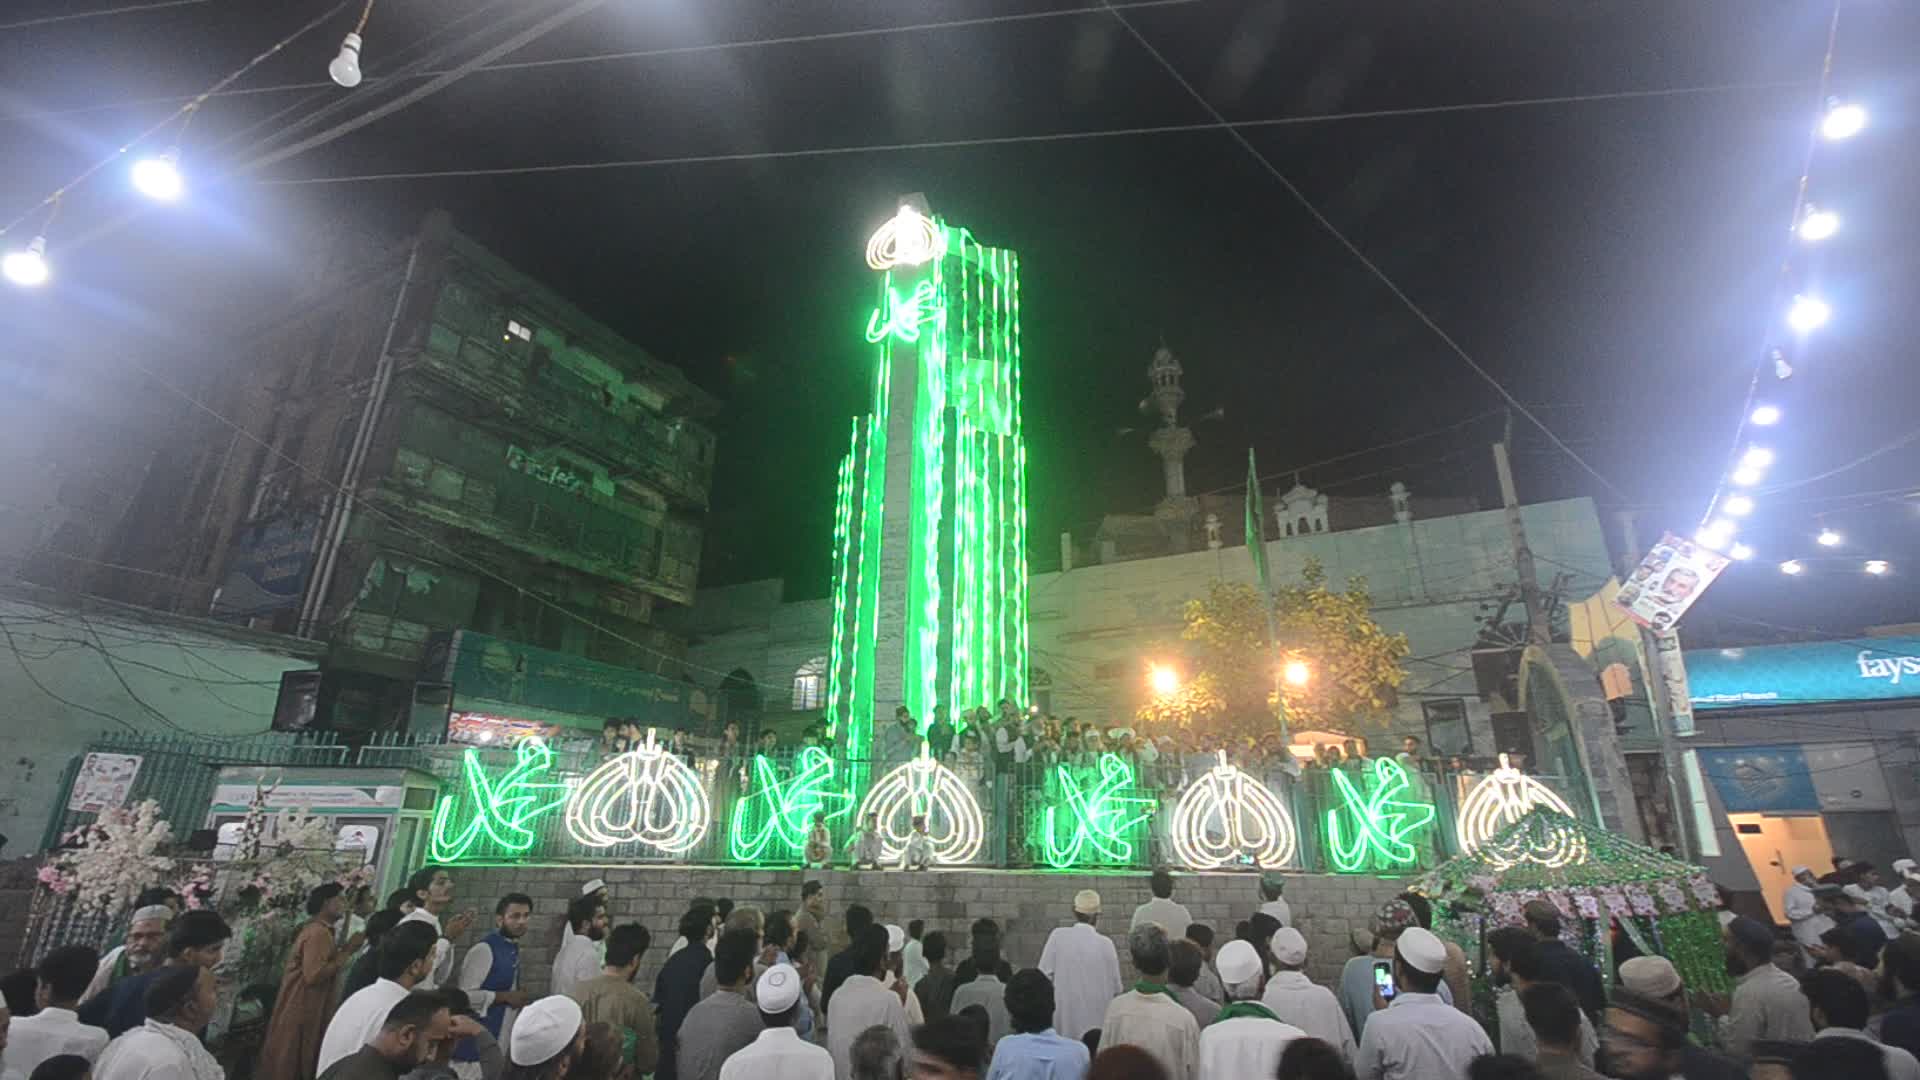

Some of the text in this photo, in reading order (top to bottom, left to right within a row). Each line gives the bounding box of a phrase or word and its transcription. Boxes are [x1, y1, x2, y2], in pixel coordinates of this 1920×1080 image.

[1856, 650, 1920, 685] fays
[431, 735, 572, 862] محمد
[732, 746, 856, 861] محمد
[1046, 753, 1157, 868] محمد
[1328, 757, 1435, 870] محمد
